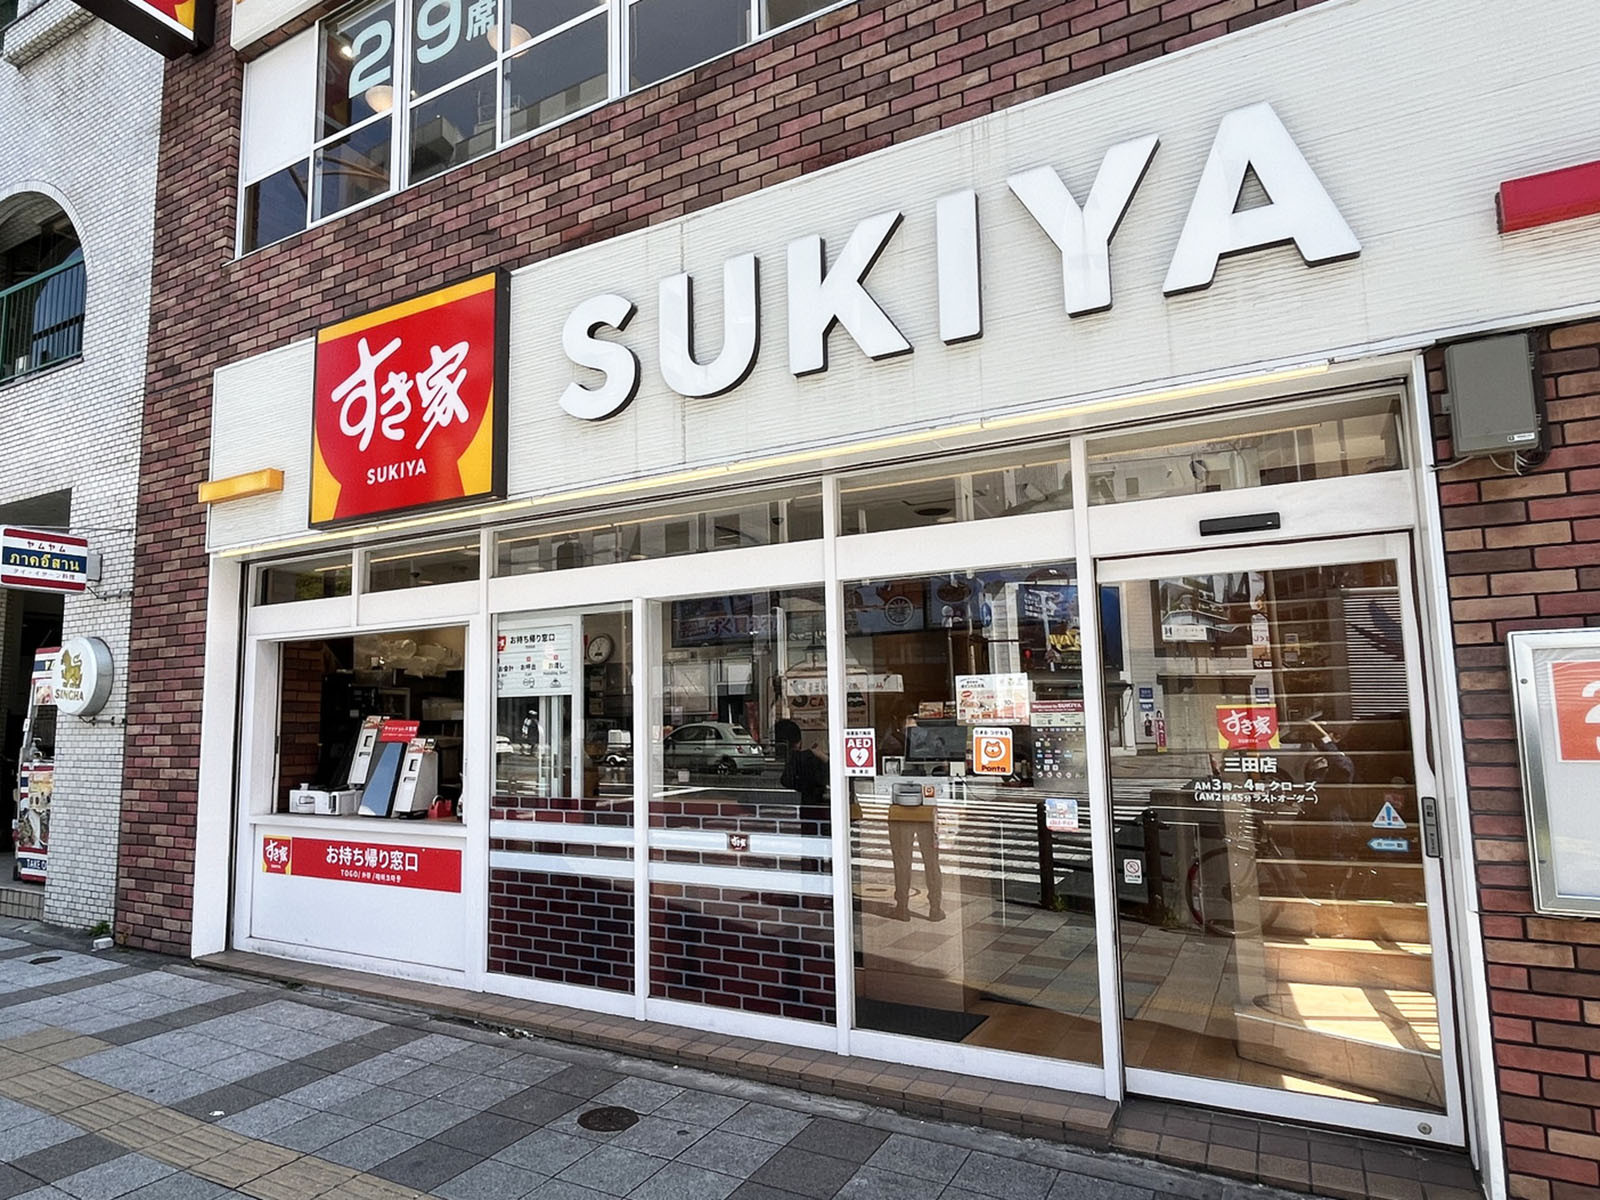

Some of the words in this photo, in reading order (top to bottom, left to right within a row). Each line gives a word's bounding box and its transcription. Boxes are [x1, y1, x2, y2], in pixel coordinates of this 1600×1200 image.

[559, 102, 1362, 421] SUKIYA
[331, 337, 470, 451] すき家
[366, 458, 427, 485] SUKIYA
[510, 633, 555, 645] お持ち帰り窓口
[1222, 709, 1272, 737] すき家
[847, 739, 872, 748] AED
[1223, 757, 1277, 773] 三田店
[1268, 780, 1317, 792] クローズ
[265, 839, 289, 865] すき家
[325, 844, 419, 873] お持ち帰り窓口
